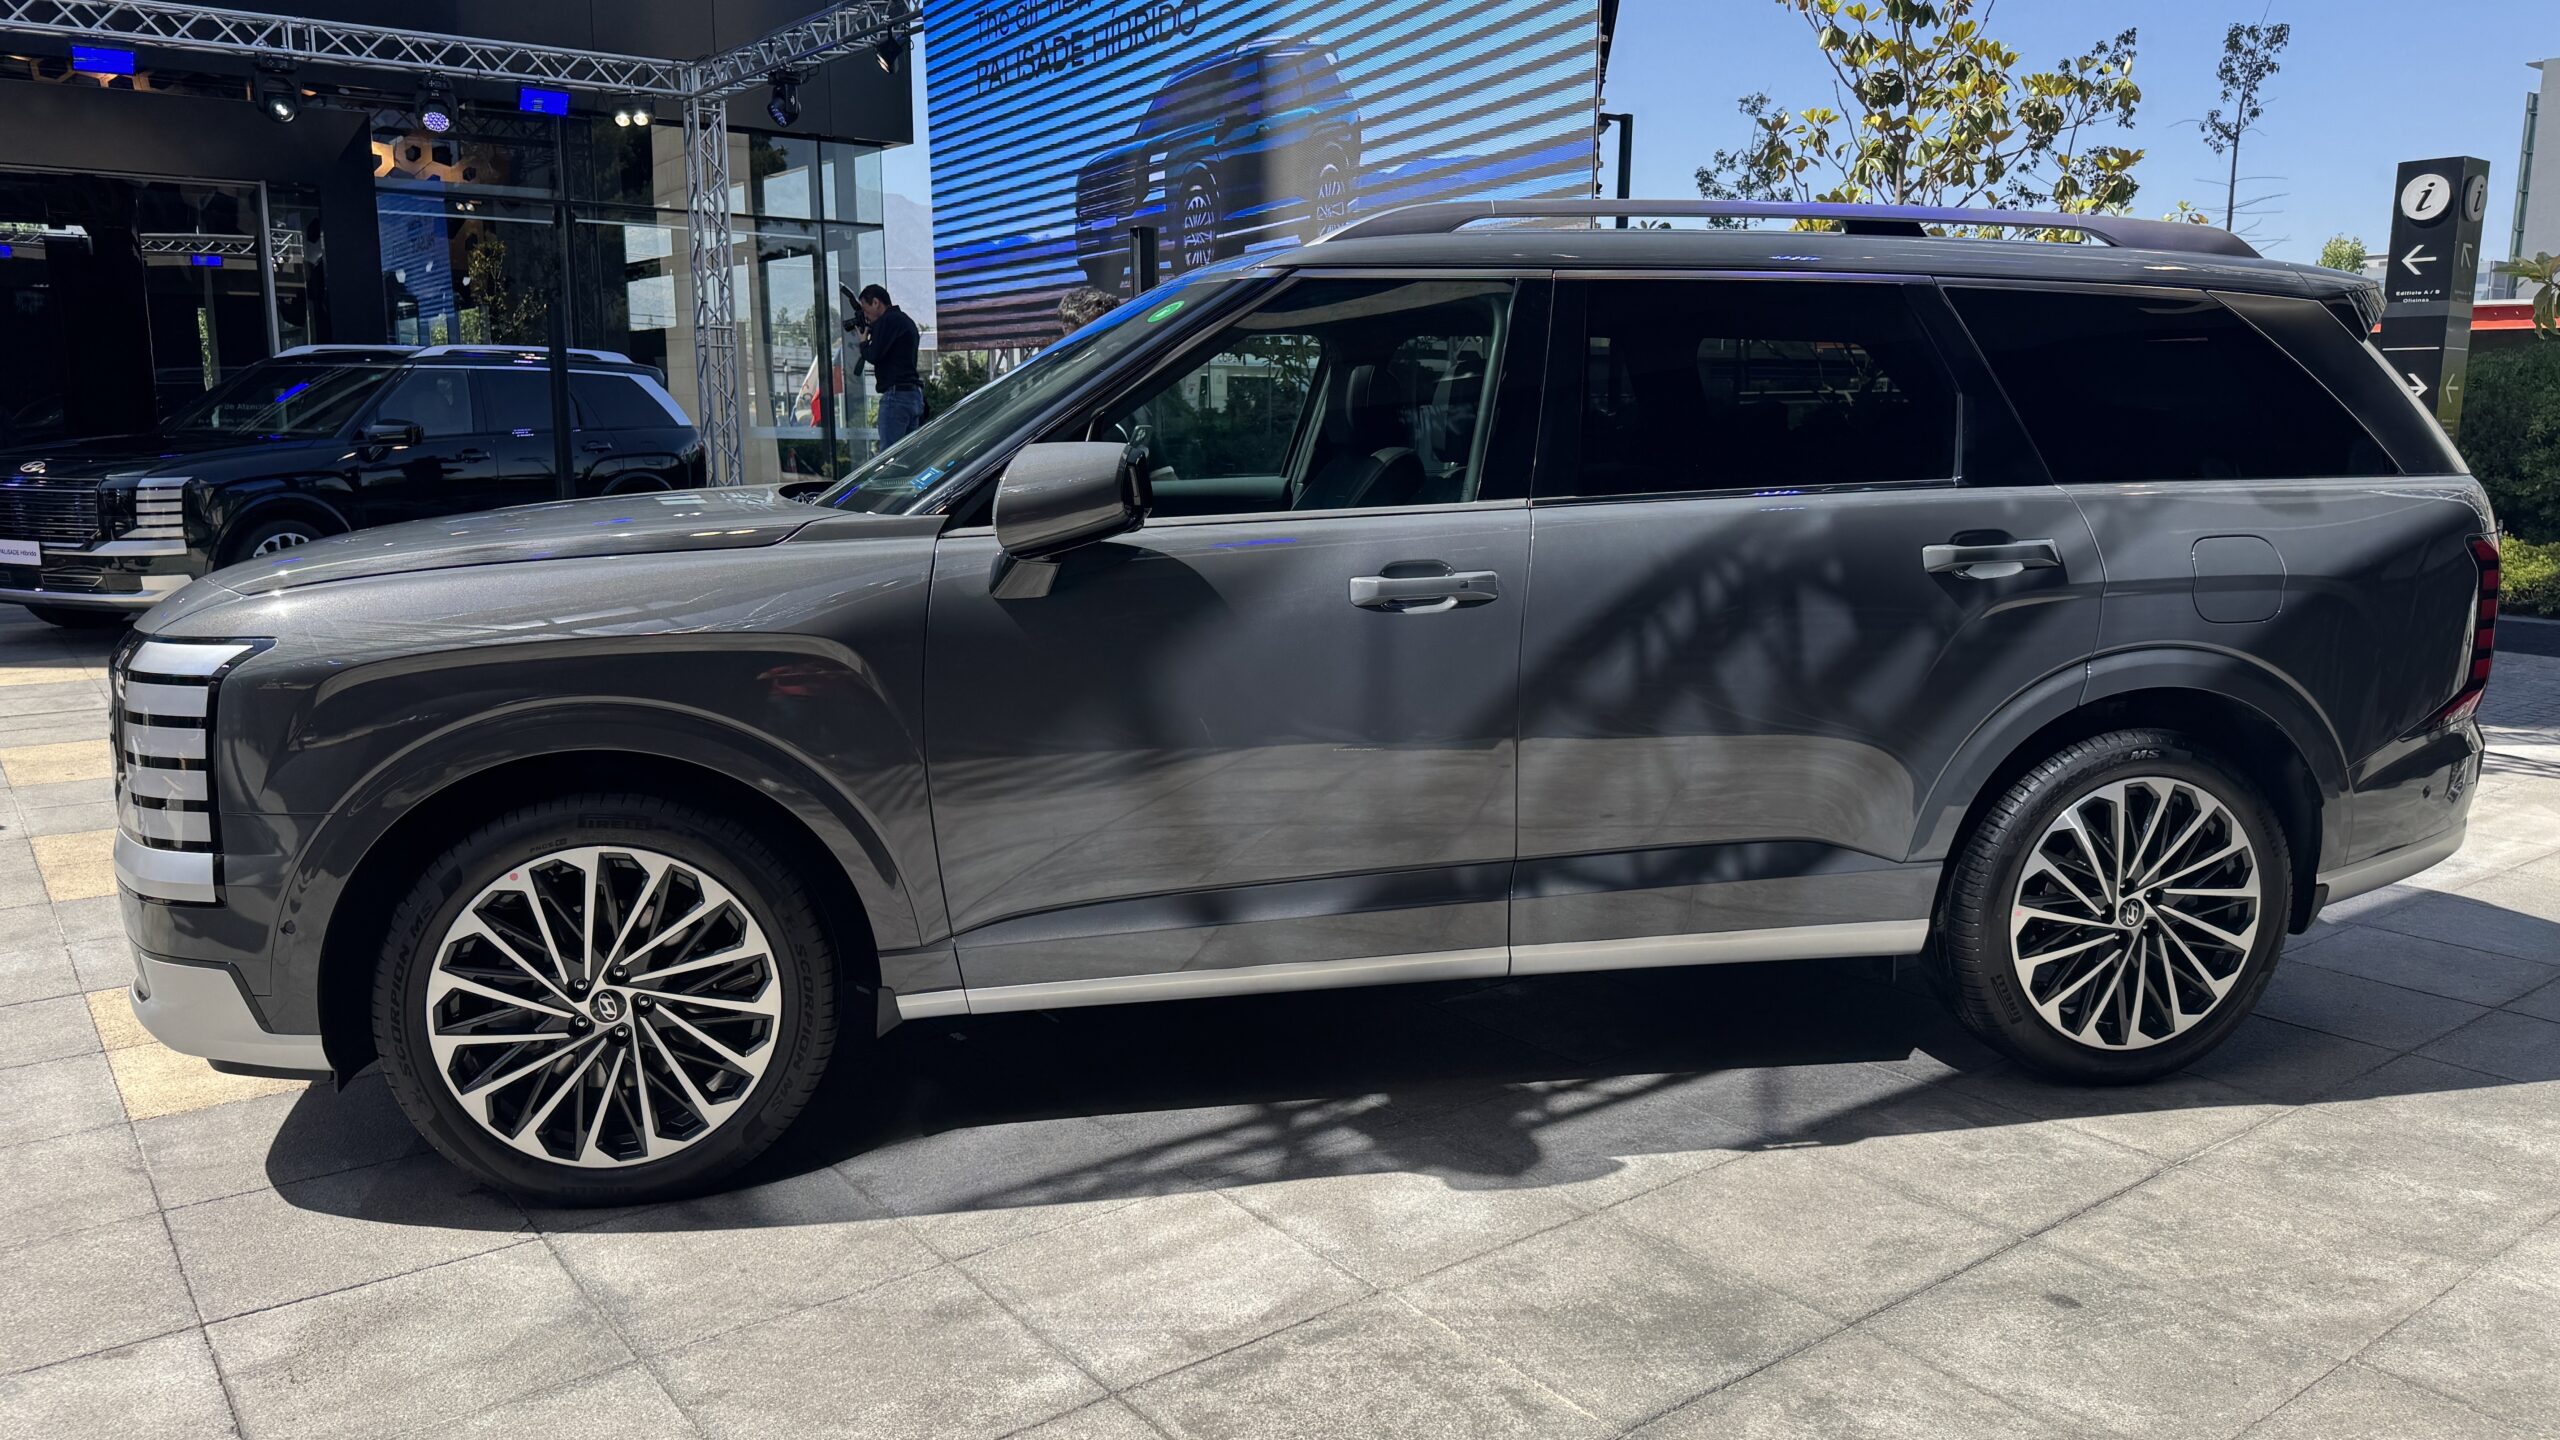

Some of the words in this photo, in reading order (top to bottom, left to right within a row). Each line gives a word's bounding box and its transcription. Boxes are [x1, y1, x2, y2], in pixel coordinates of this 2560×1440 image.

[974, 7, 1010, 43] The
[976, 28, 1085, 94] PALISADE
[2130, 748, 2161, 761] MS
[390, 945, 412, 1079] SCORPION
[793, 942, 813, 1072] SCORPION
